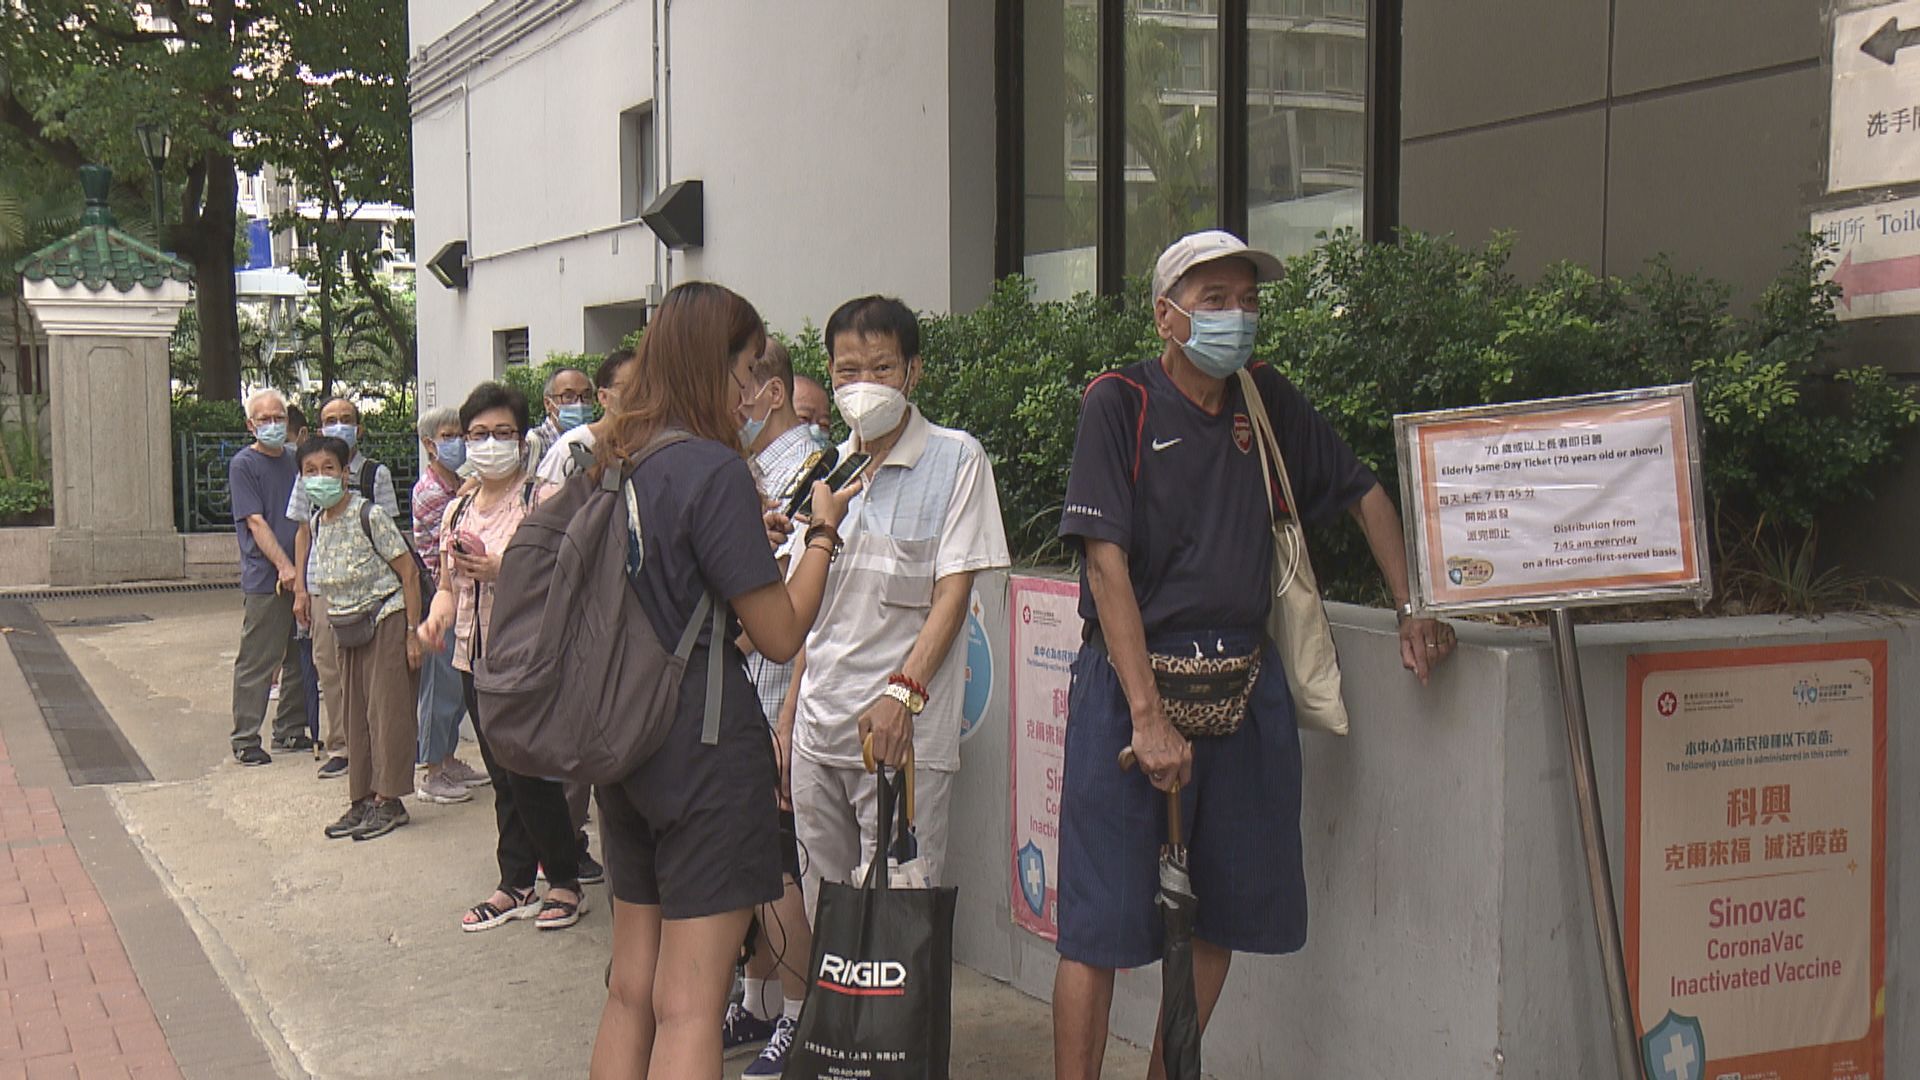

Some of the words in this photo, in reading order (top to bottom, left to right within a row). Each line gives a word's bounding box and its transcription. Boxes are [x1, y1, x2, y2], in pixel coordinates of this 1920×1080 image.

[1877, 208, 1920, 235] Toil
[1441, 465, 1473, 476] Elderly
[1475, 459, 1521, 473] Same-Day
[1524, 457, 1551, 468] Ticket
[1554, 455, 1569, 467] (70
[1571, 453, 1597, 465] years
[1599, 449, 1614, 460] old
[1616, 450, 1627, 458] or
[1630, 444, 1663, 457] above)
[1485, 445, 1499, 456] 70
[1066, 504, 1103, 517] ARSENAL
[1553, 521, 1610, 534] Distribution
[1613, 518, 1636, 528] from
[1554, 540, 1574, 551] 7:45
[1576, 540, 1592, 549] am
[1594, 535, 1638, 548] everyday
[1522, 561, 1535, 569] on
[1545, 549, 1650, 567] first-come-first-served
[1652, 547, 1677, 558] basis
[1666, 761, 1680, 772] The
[1681, 757, 1716, 772] following
[1717, 757, 1745, 767] vaccine
[1754, 749, 1801, 764] administered
[1803, 749, 1810, 759] in
[1810, 748, 1824, 759] this
[1045, 798, 1060, 817] Co
[1726, 784, 1791, 828] 科興
[1664, 837, 1751, 871] 克爾來福
[1764, 828, 1849, 861] 滅活疫苗
[1708, 896, 1806, 928] Sinovac
[1707, 930, 1803, 961] CoronaVac
[1670, 964, 1770, 998] Inactivated
[1774, 957, 1841, 983] Vaccine
